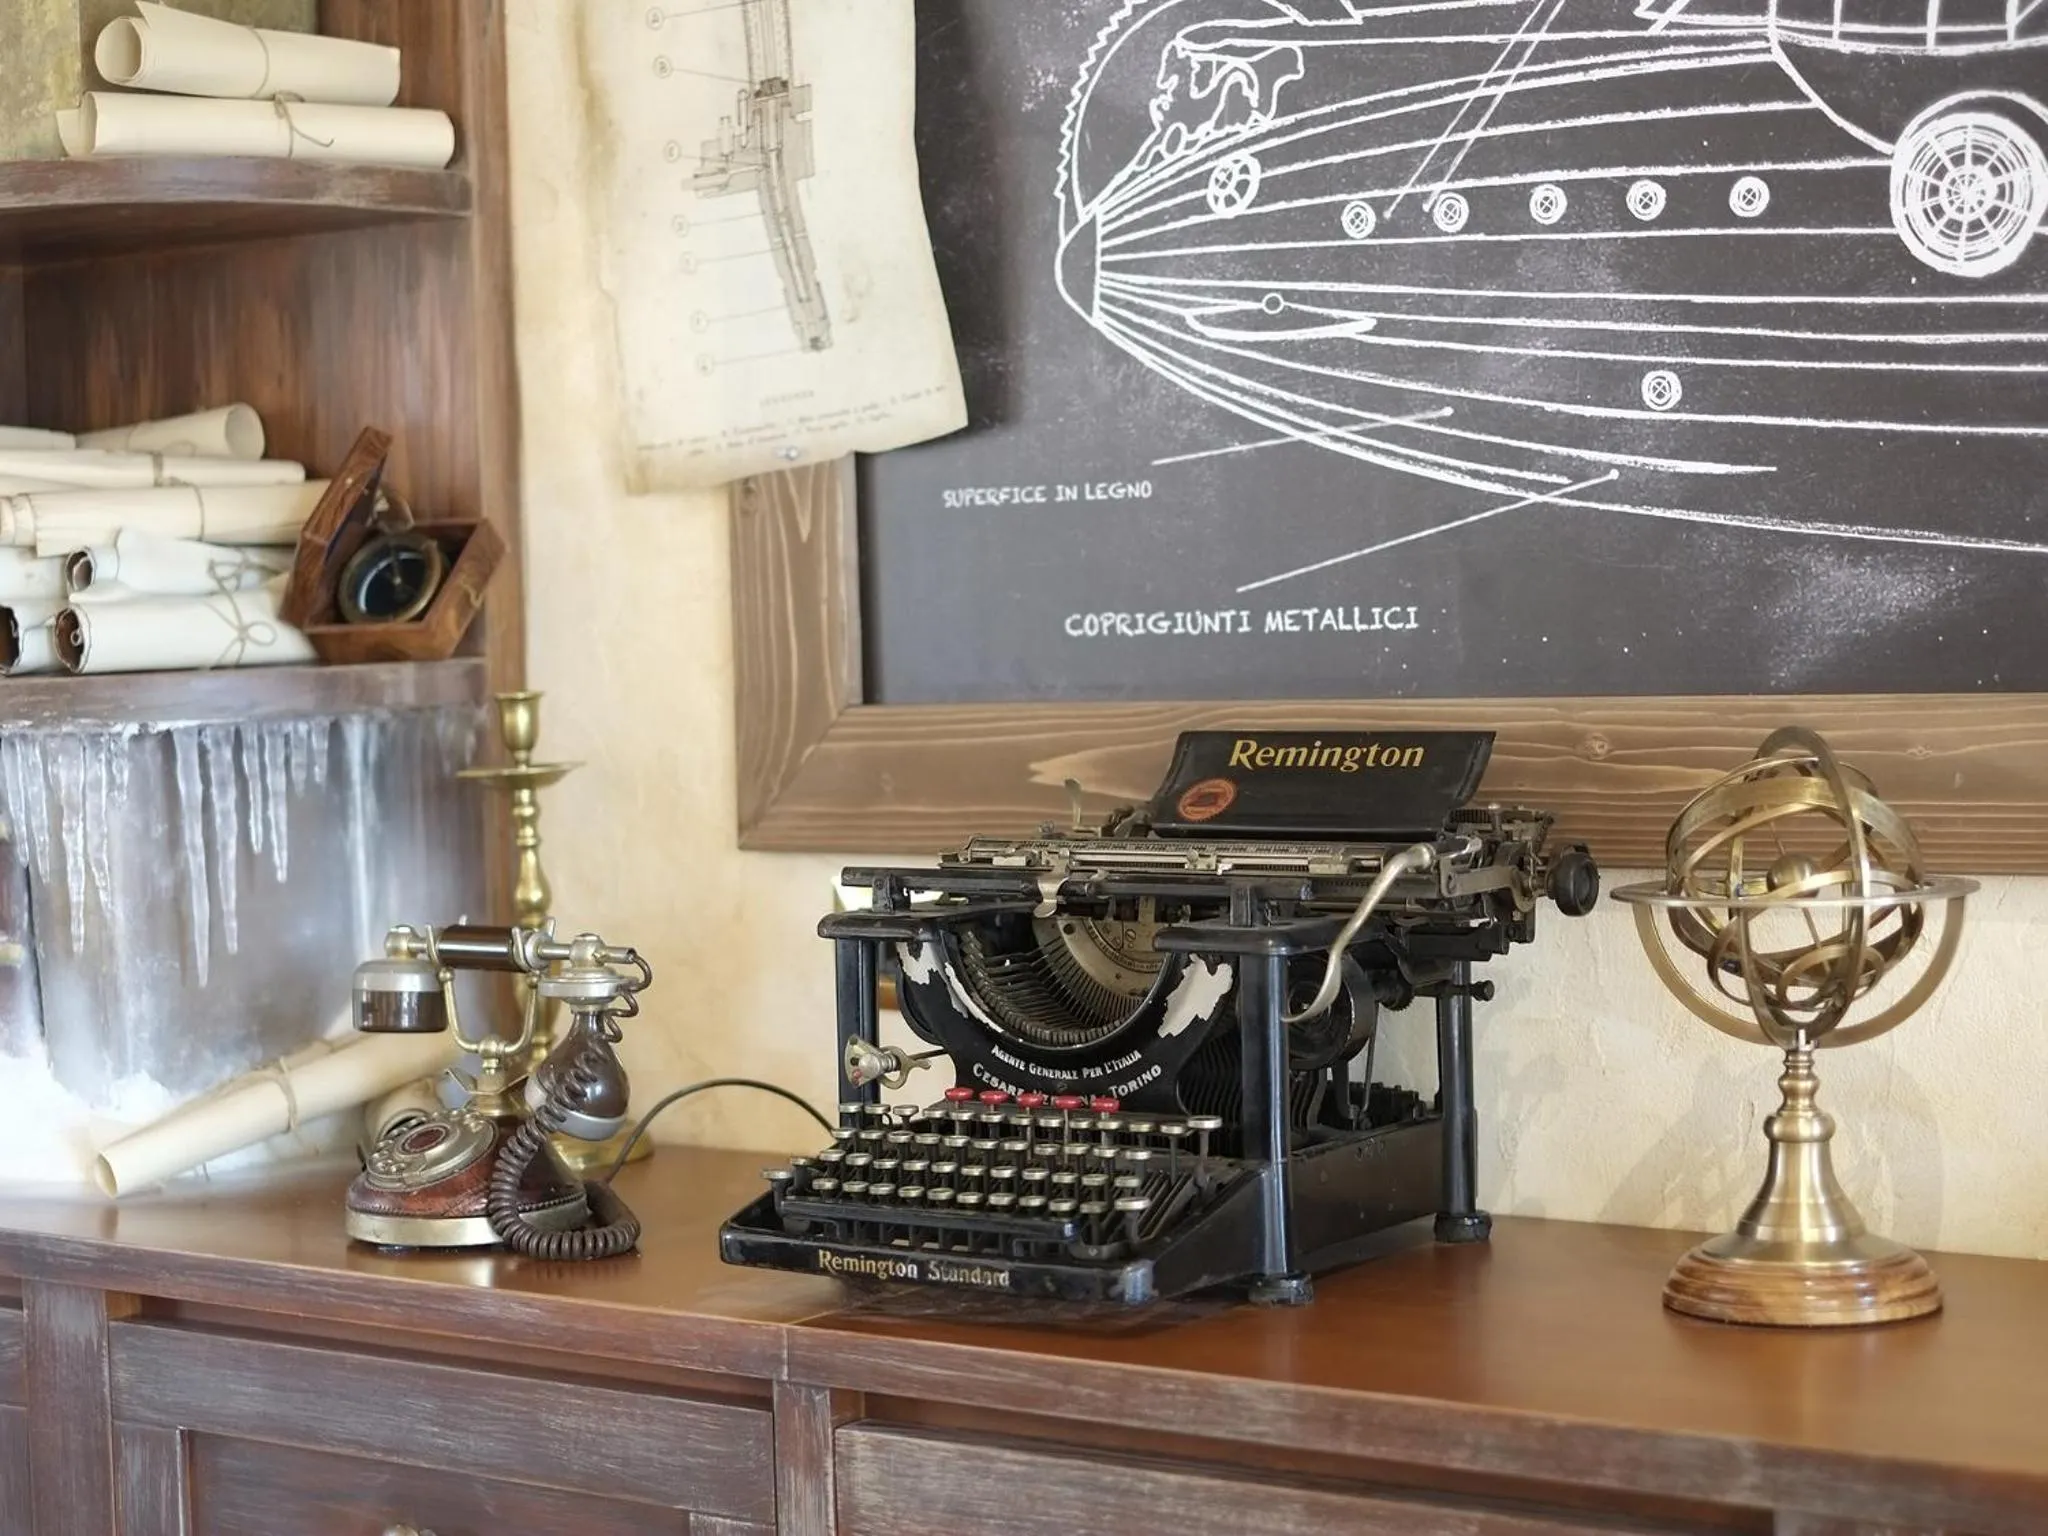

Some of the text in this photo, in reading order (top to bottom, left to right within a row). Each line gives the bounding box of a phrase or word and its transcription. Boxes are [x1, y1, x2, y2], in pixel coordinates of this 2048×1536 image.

[942, 480, 1153, 507] SUPERFICE IN LEGNO
[1064, 606, 1419, 637] COPRIGIUNTI METALLICI
[1228, 739, 1425, 773] Remington
[1108, 1064, 1162, 1098] TORINO
[818, 1249, 918, 1280] Remington
